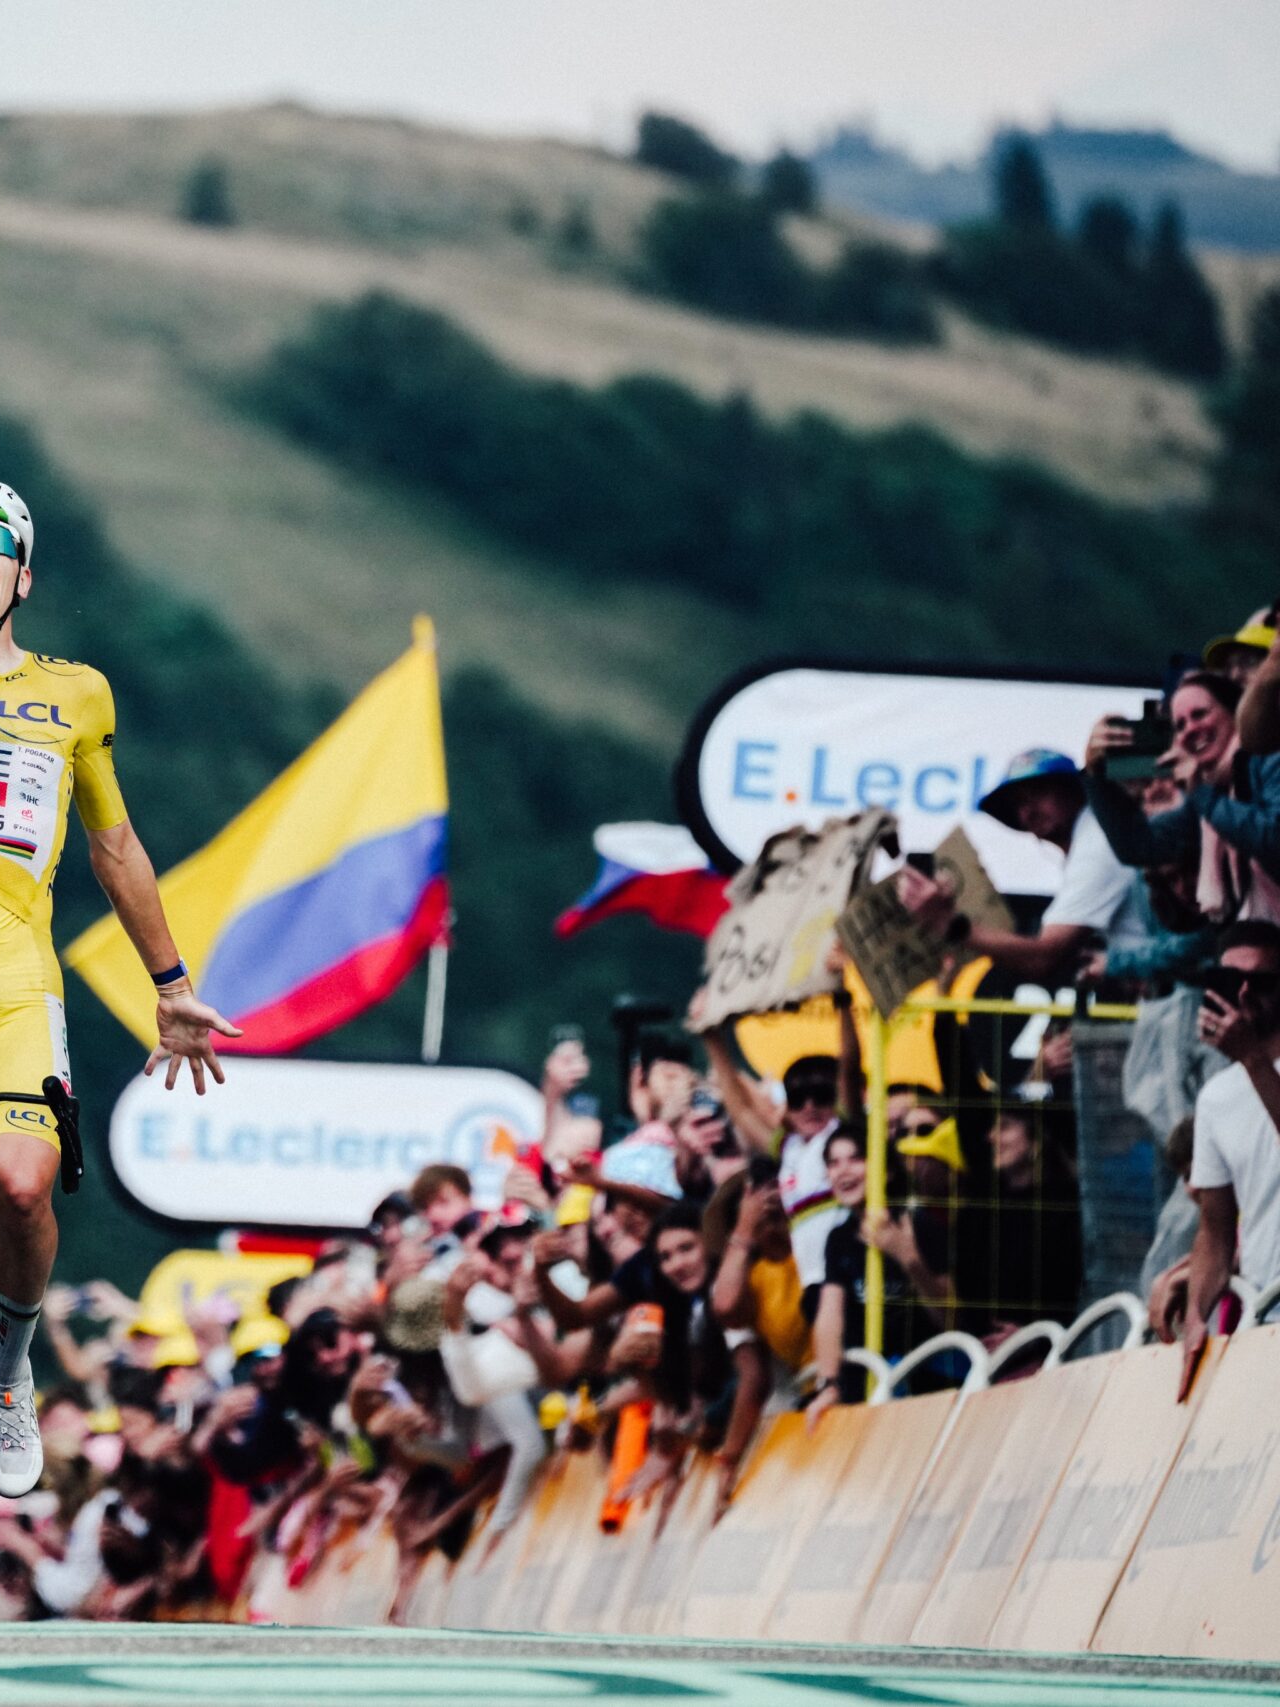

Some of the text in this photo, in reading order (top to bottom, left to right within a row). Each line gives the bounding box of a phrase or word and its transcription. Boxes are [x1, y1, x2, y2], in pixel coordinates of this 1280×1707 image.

[5, 672, 28, 682] LCL
[732, 740, 988, 812] E.Lecl
[11, 1109, 51, 1129] LCL
[138, 1112, 434, 1170] E.Leclerc
